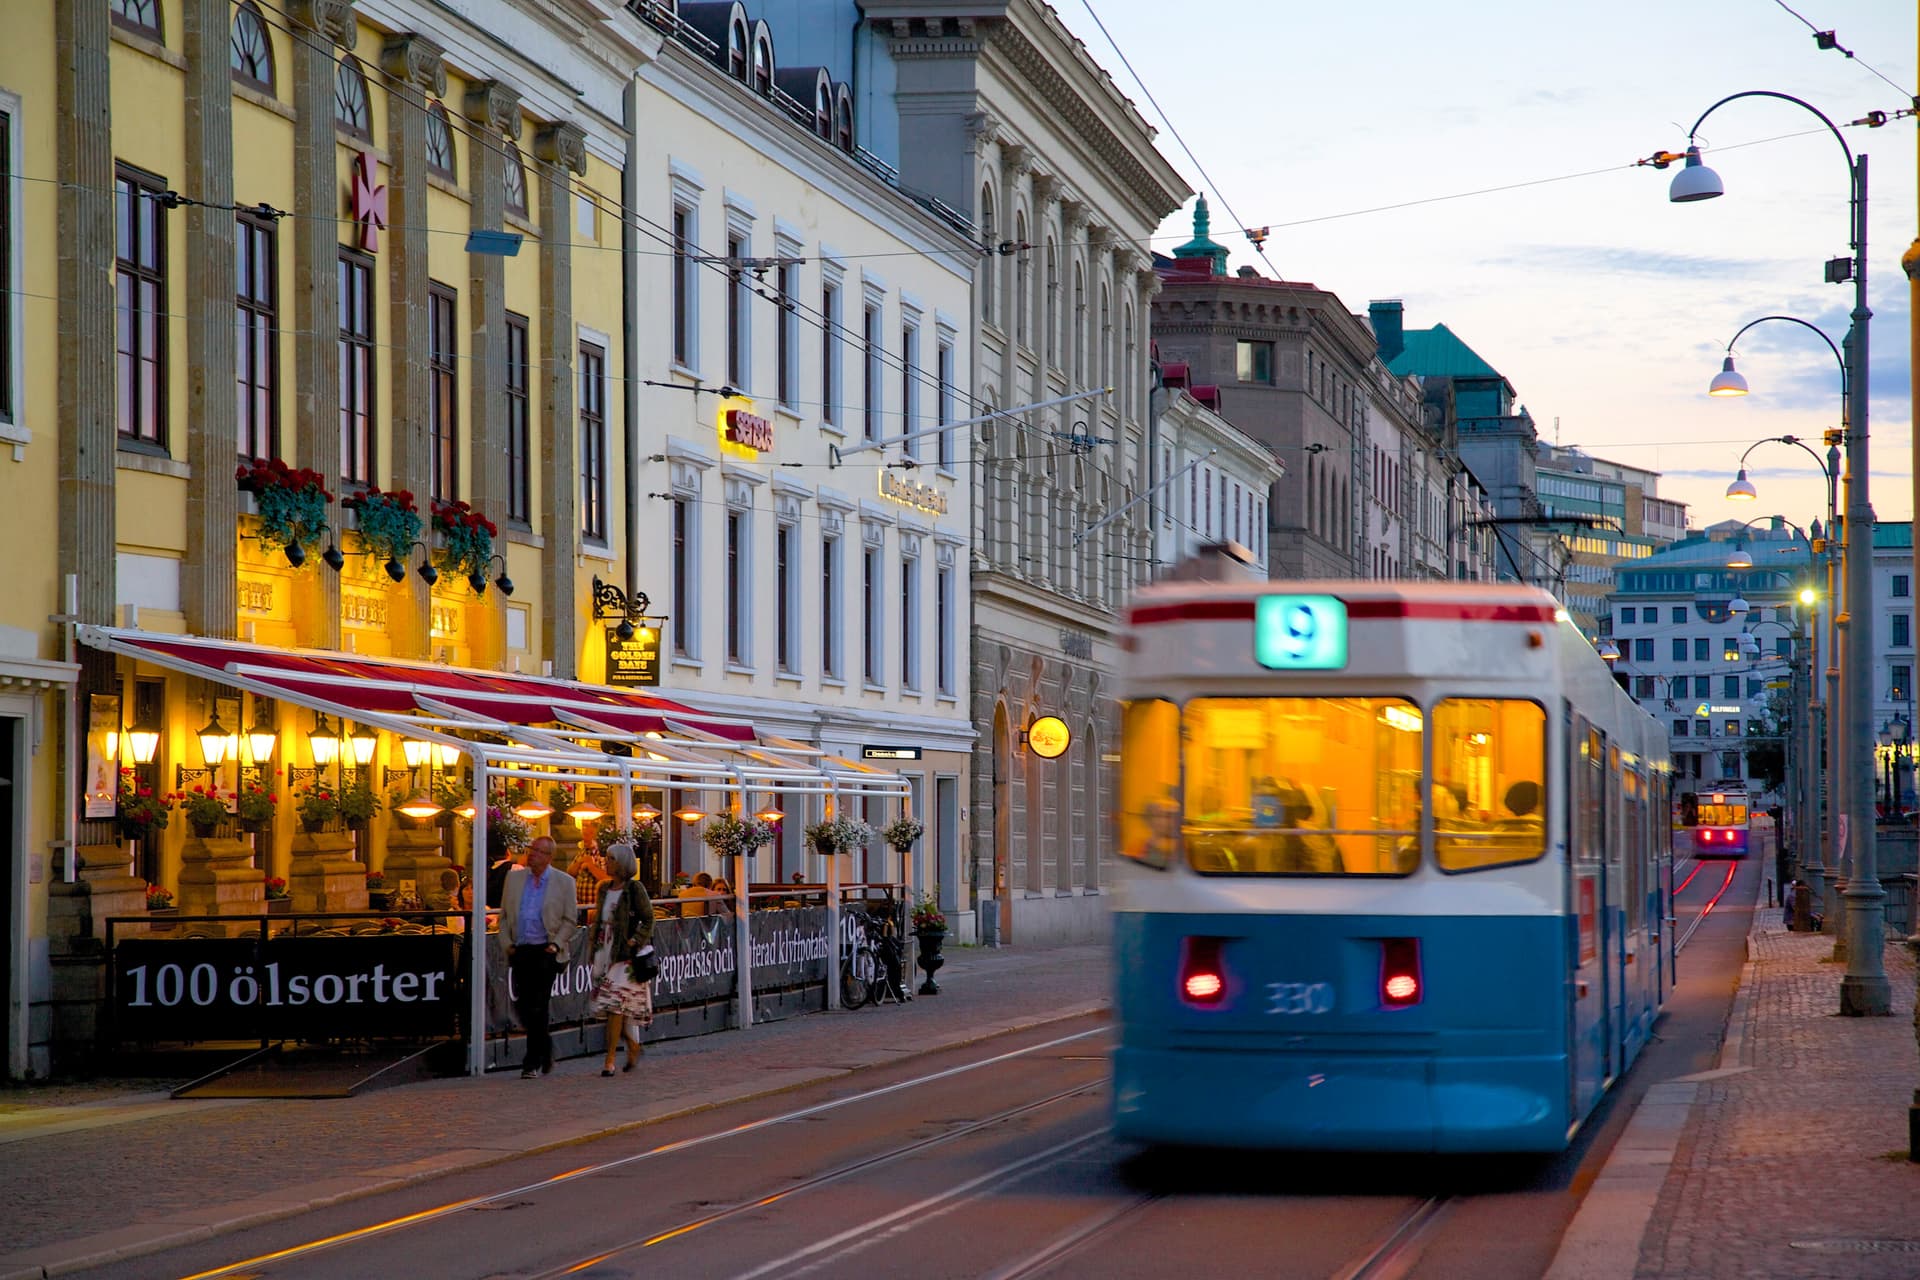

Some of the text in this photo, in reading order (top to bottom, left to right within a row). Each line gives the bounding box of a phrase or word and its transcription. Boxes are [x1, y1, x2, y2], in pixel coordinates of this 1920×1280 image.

[621, 641, 646, 651] THE
[1285, 604, 1317, 661] 9
[610, 651, 656, 661] GOLDEN
[618, 660, 648, 670] DAYS
[713, 935, 735, 973] och
[778, 925, 829, 976] klyftpotatis
[126, 962, 446, 1006] 100 ölsorter
[1264, 982, 1334, 1015] 330
